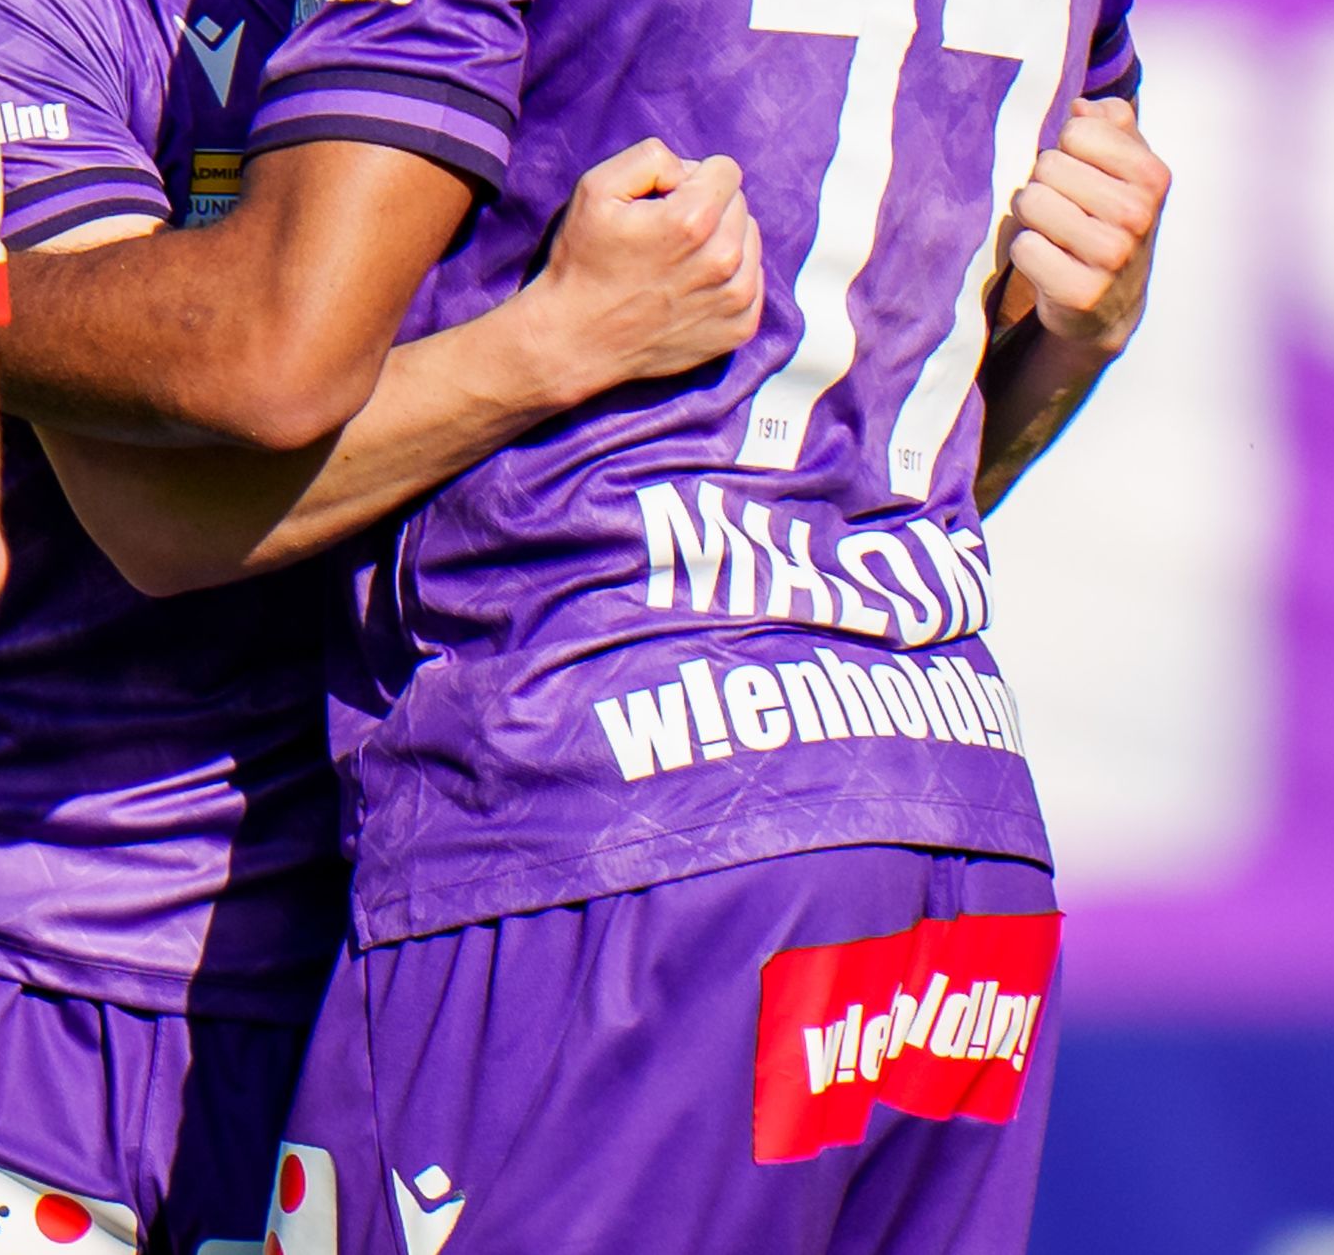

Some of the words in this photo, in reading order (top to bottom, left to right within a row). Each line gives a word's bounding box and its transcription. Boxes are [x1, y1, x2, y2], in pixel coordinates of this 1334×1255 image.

[758, 417, 789, 441] 1911
[897, 448, 923, 472] 1911
[636, 480, 993, 646] MALON
